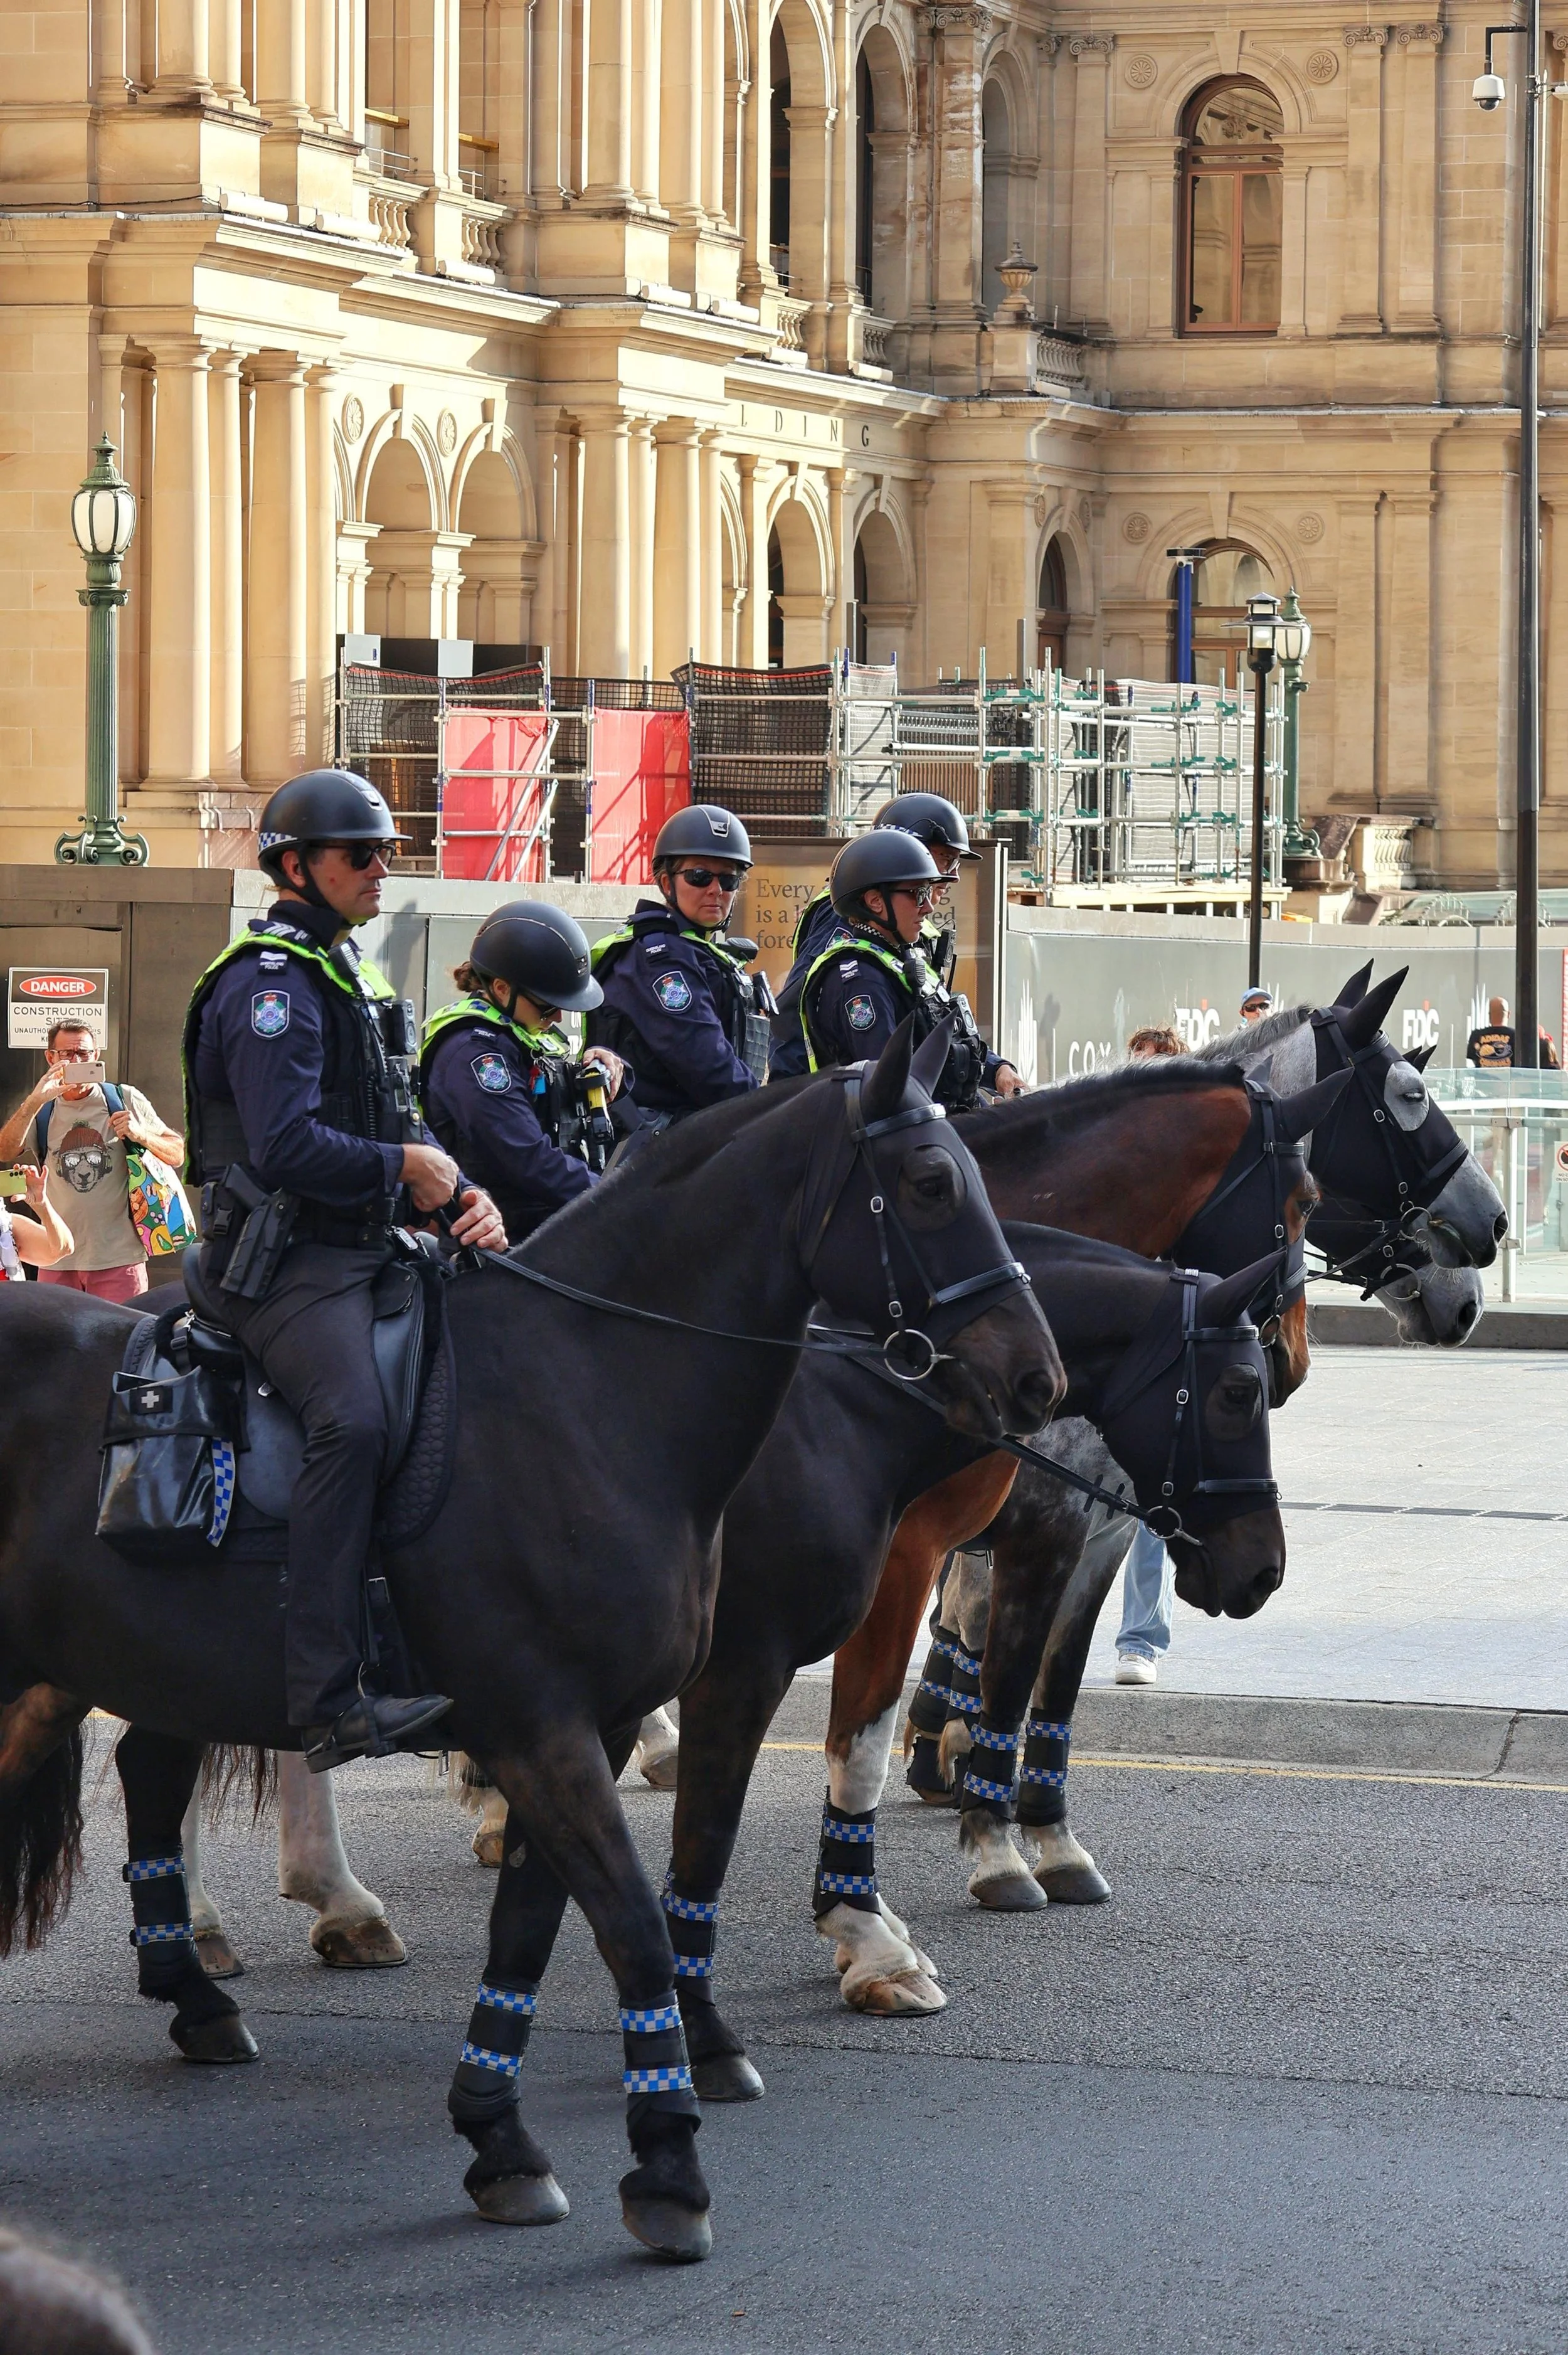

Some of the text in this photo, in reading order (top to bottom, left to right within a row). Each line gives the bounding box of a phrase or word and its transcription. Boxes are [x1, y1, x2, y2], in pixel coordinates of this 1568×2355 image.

[756, 878, 815, 904] Every
[756, 904, 773, 923] is
[778, 909, 789, 923] a
[31, 982, 85, 993] DANGER
[13, 1006, 102, 1016] CONSTRUCTION
[45, 1017, 70, 1026] SIT
[1402, 1008, 1439, 1050] FDC
